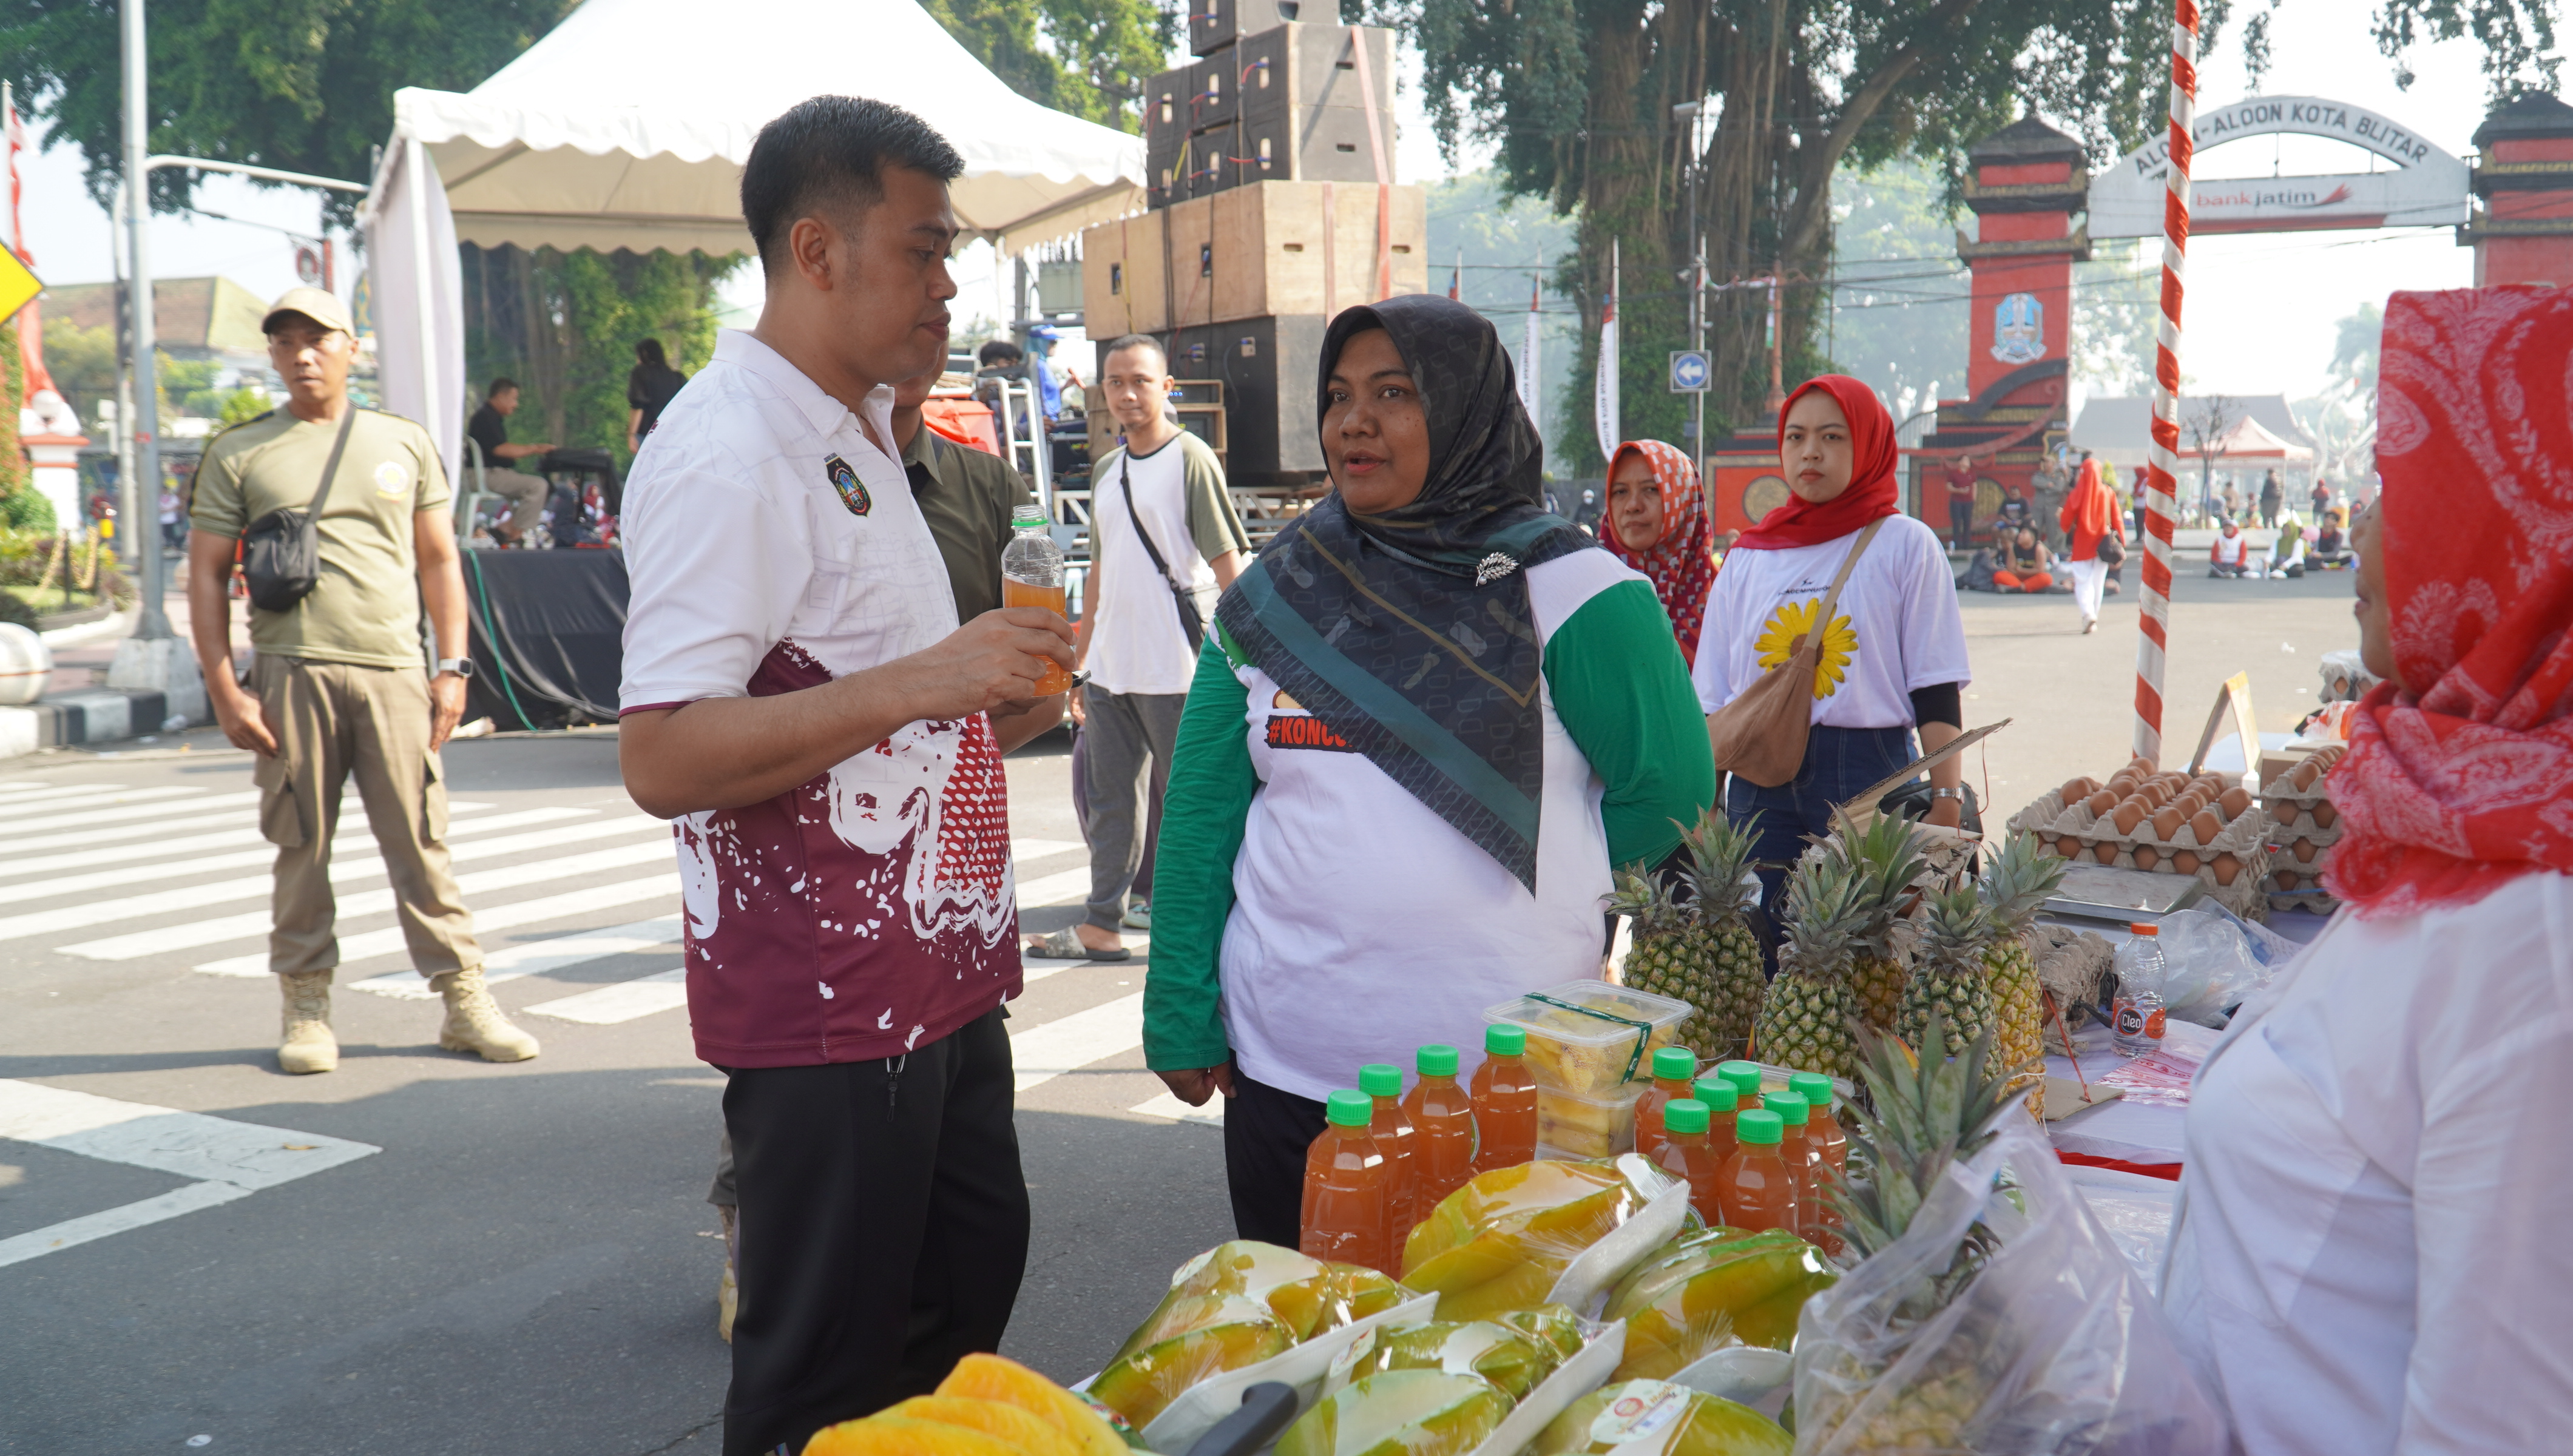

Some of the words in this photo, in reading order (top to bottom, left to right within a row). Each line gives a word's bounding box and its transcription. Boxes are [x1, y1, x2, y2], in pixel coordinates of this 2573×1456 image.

[2291, 105, 2347, 129] KOTA
[2355, 116, 2428, 164] BLITAR
[2122, 1013, 2142, 1029] Cleo
